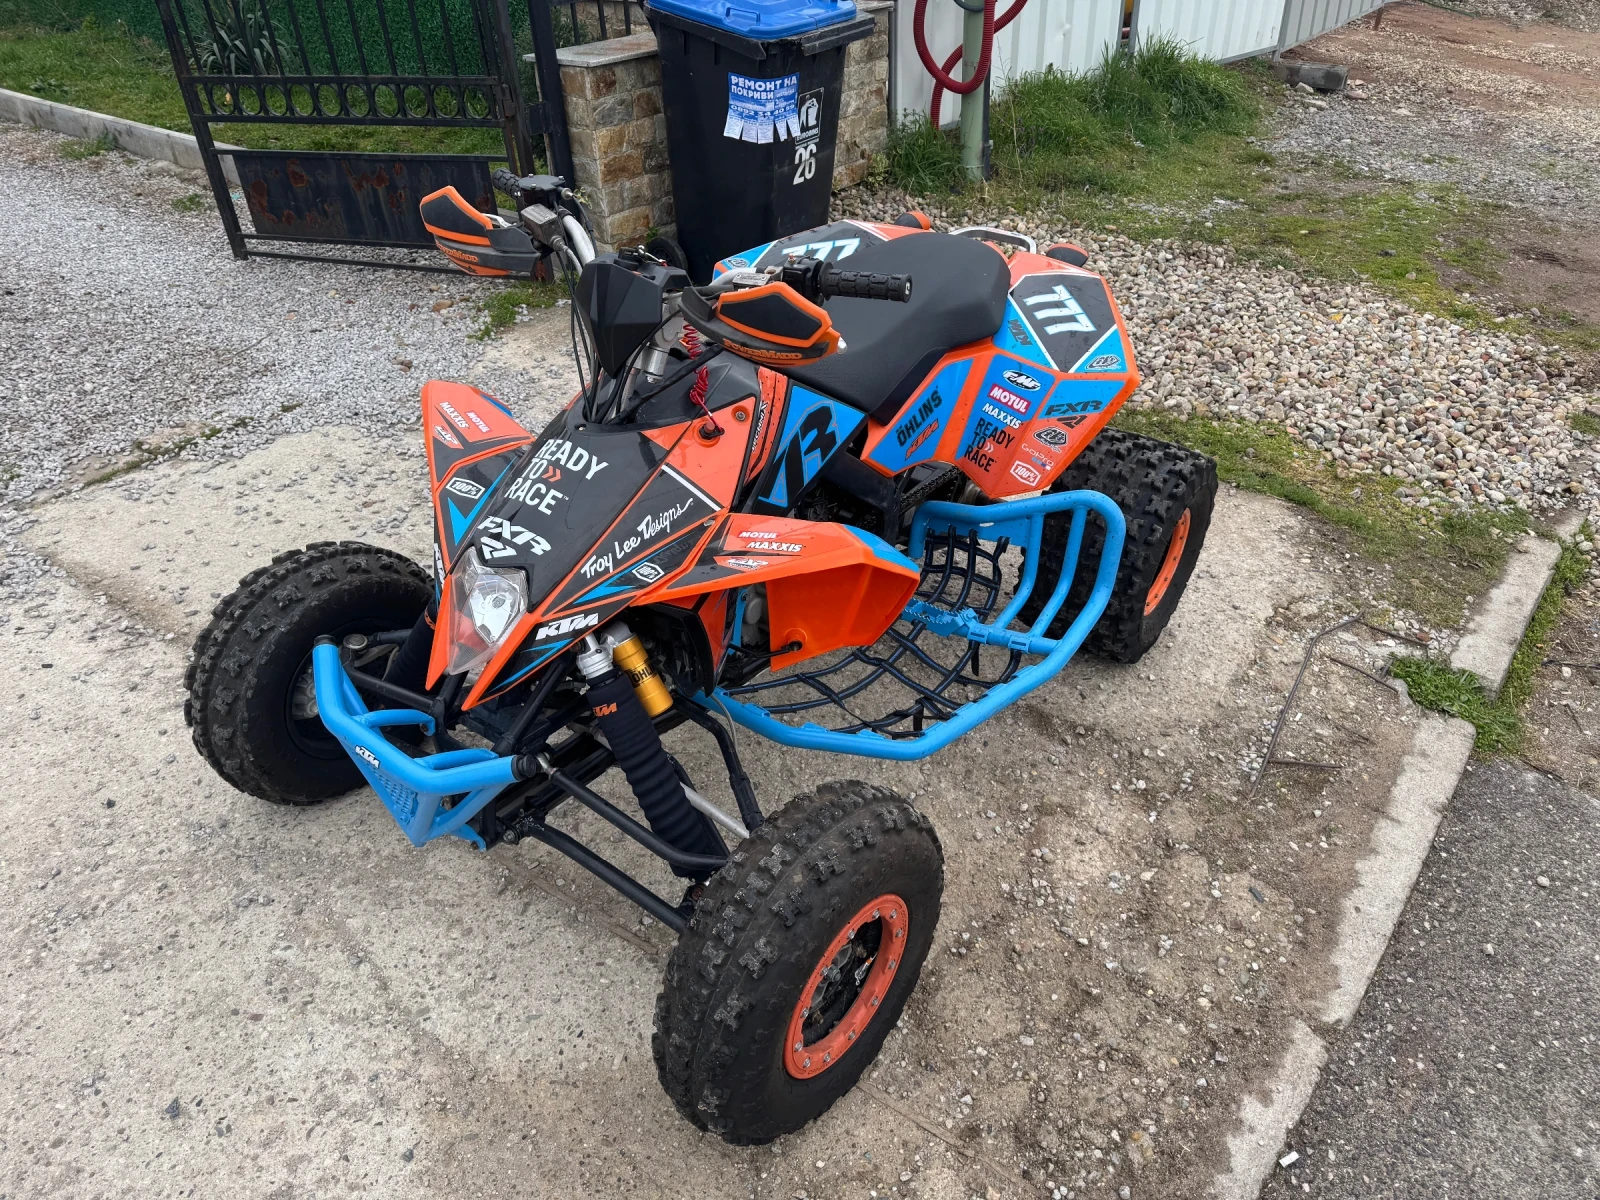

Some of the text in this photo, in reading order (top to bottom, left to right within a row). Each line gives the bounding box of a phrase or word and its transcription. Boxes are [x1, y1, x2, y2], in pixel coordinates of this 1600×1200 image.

[731, 75, 797, 91] РЕМОНТ НА
[731, 85, 774, 100] ПОКРИВИ
[793, 144, 817, 185] 26
[1023, 284, 1097, 335] 777
[1003, 370, 1041, 389] FMF
[989, 386, 1029, 413] MOTUL
[1045, 400, 1104, 416] FXR
[439, 401, 470, 429] MAXXIS
[466, 411, 491, 433] MOTUL
[896, 389, 943, 447] ÖHLINS
[982, 403, 1022, 429] MAXXIS
[971, 431, 987, 450] TO
[975, 418, 1015, 449] READY
[522, 459, 545, 480] TO
[537, 439, 608, 480] READY
[964, 444, 995, 473] RACE
[1015, 463, 1037, 483] 100%
[452, 481, 479, 496] 100%
[505, 480, 565, 516] RACE
[477, 515, 552, 556] FXR
[580, 553, 613, 579] Troy
[614, 536, 641, 559] Lee
[637, 497, 693, 539] Designs
[738, 531, 778, 540] MOTUL
[746, 541, 803, 553] MAXXIS
[534, 612, 599, 641] KTM
[355, 745, 381, 769] KTM
